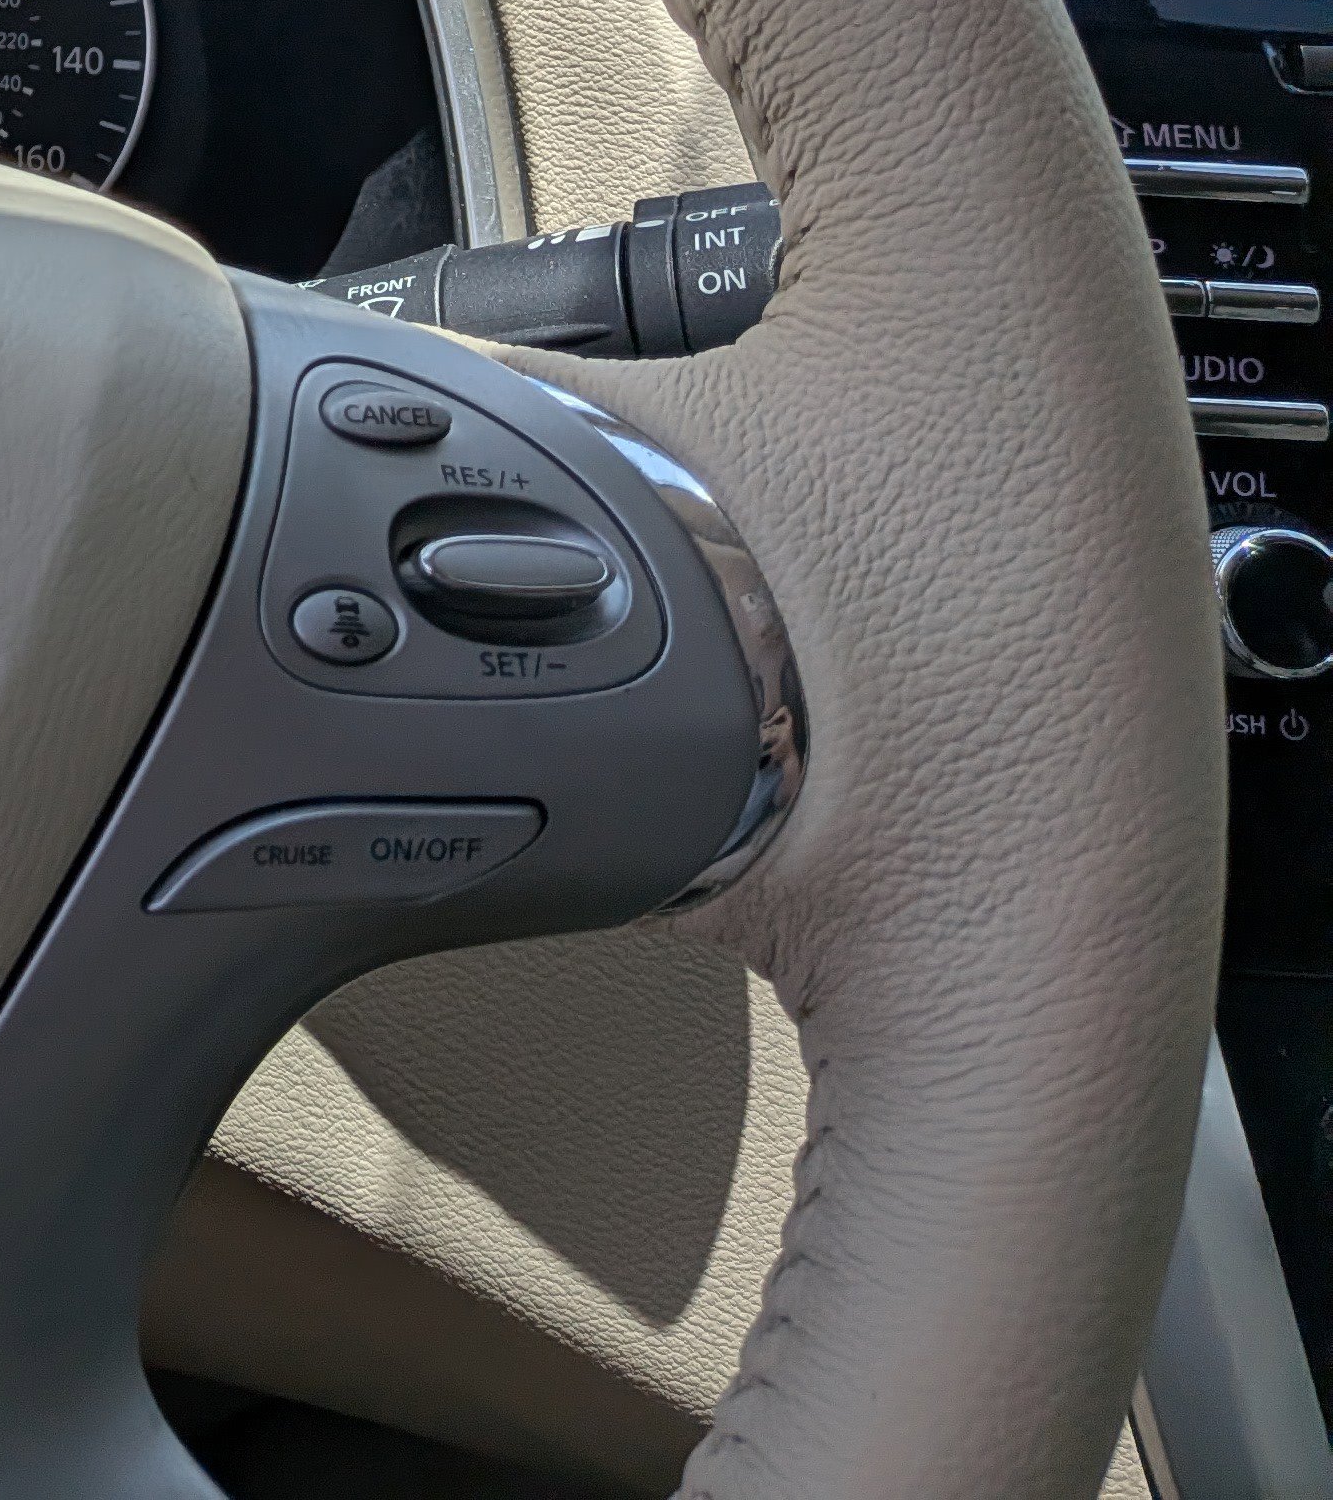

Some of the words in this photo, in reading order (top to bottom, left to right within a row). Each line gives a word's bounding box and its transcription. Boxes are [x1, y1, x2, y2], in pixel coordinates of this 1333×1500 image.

[52, 45, 104, 75] 140
[1142, 122, 1240, 151] MENU
[14, 143, 66, 174] 160
[685, 205, 748, 222] OFF
[694, 226, 745, 251] INT
[347, 275, 417, 300] FRONT
[697, 267, 746, 295] ON
[1180, 355, 1265, 383] UDIO
[343, 403, 439, 428] CANCEL
[1211, 471, 1276, 498] VOL
[253, 845, 331, 866] CRUISE
[370, 837, 481, 862] ON/OFF
